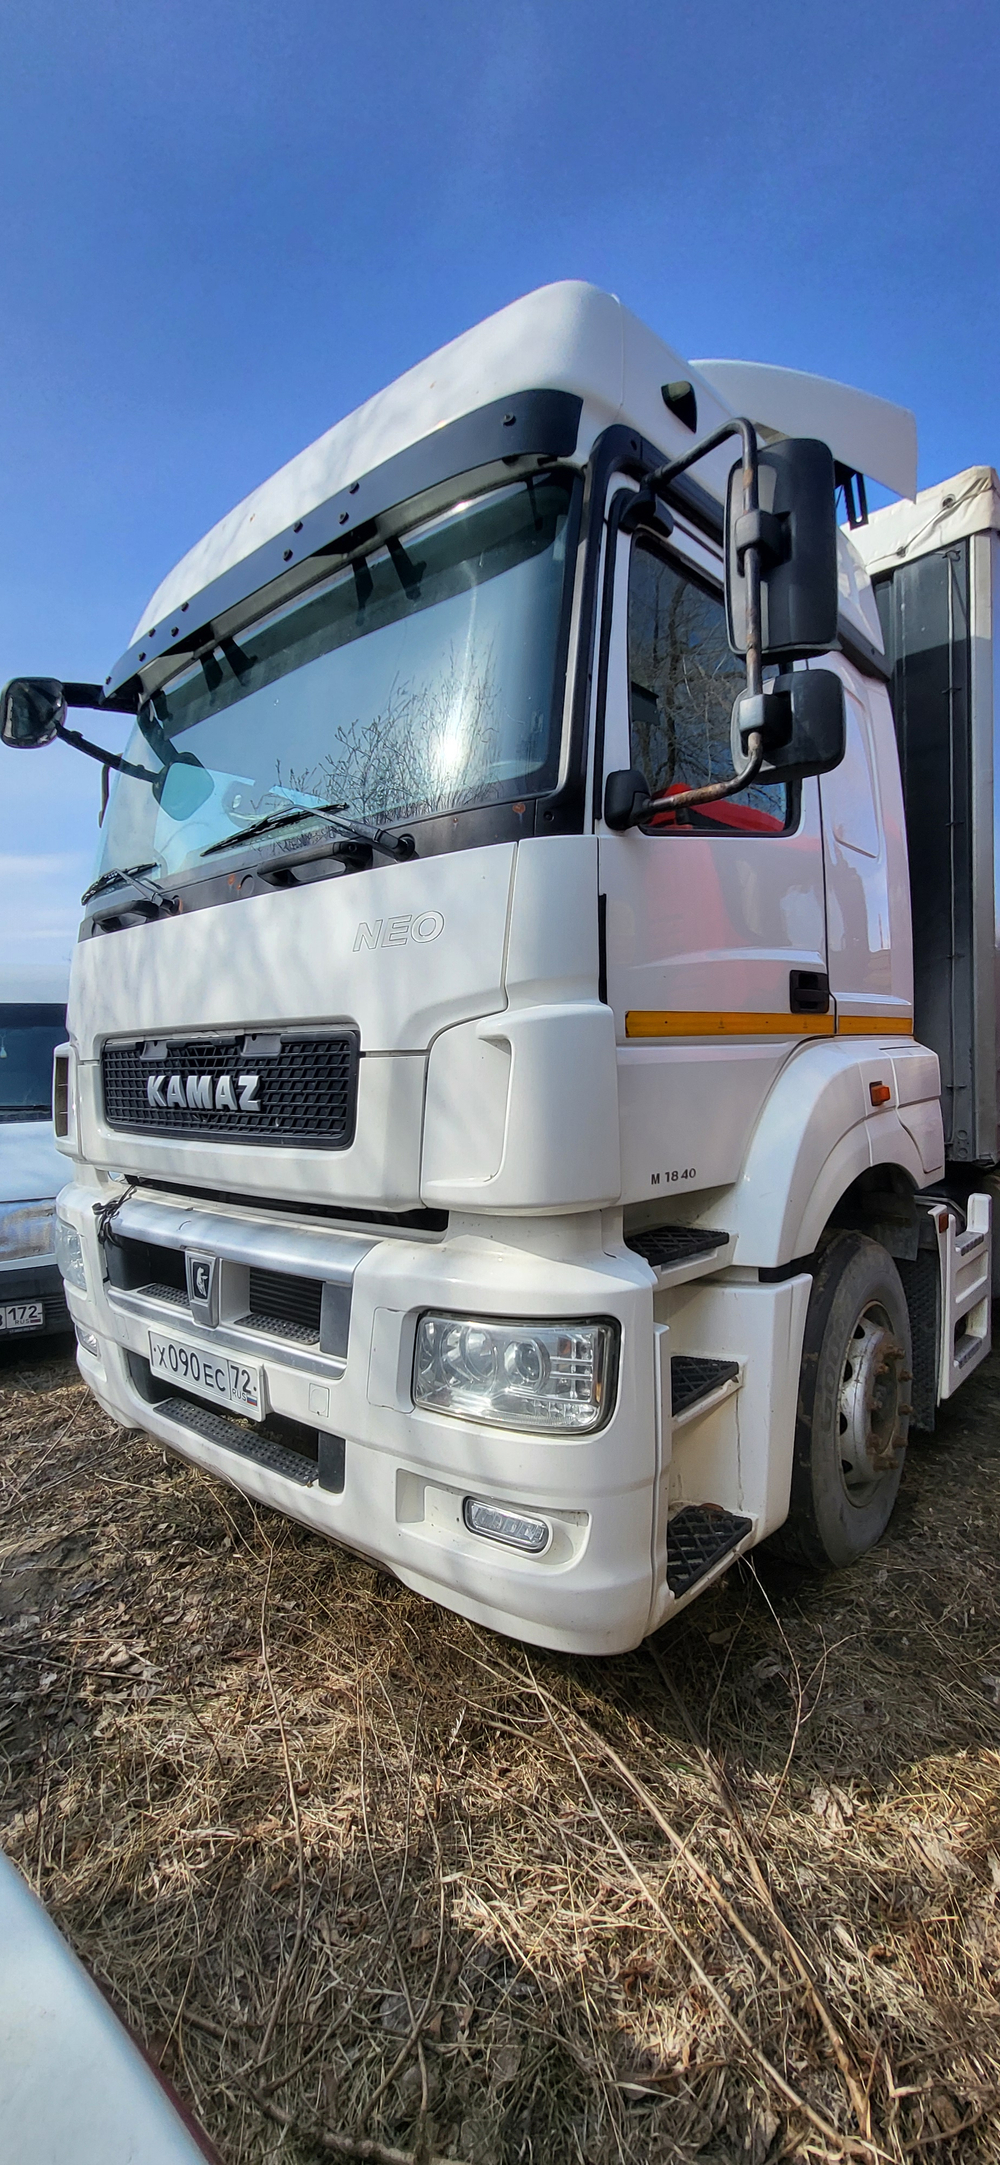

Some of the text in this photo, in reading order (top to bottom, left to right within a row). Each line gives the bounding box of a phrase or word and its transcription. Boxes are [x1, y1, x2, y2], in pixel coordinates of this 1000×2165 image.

[352, 910, 445, 952] NEO
[147, 1075, 261, 1112] KAMAZ
[651, 1173, 660, 1185] M
[8, 1305, 38, 1320] 172
[230, 1364, 252, 1395] 72
[232, 1388, 247, 1402] RUS
